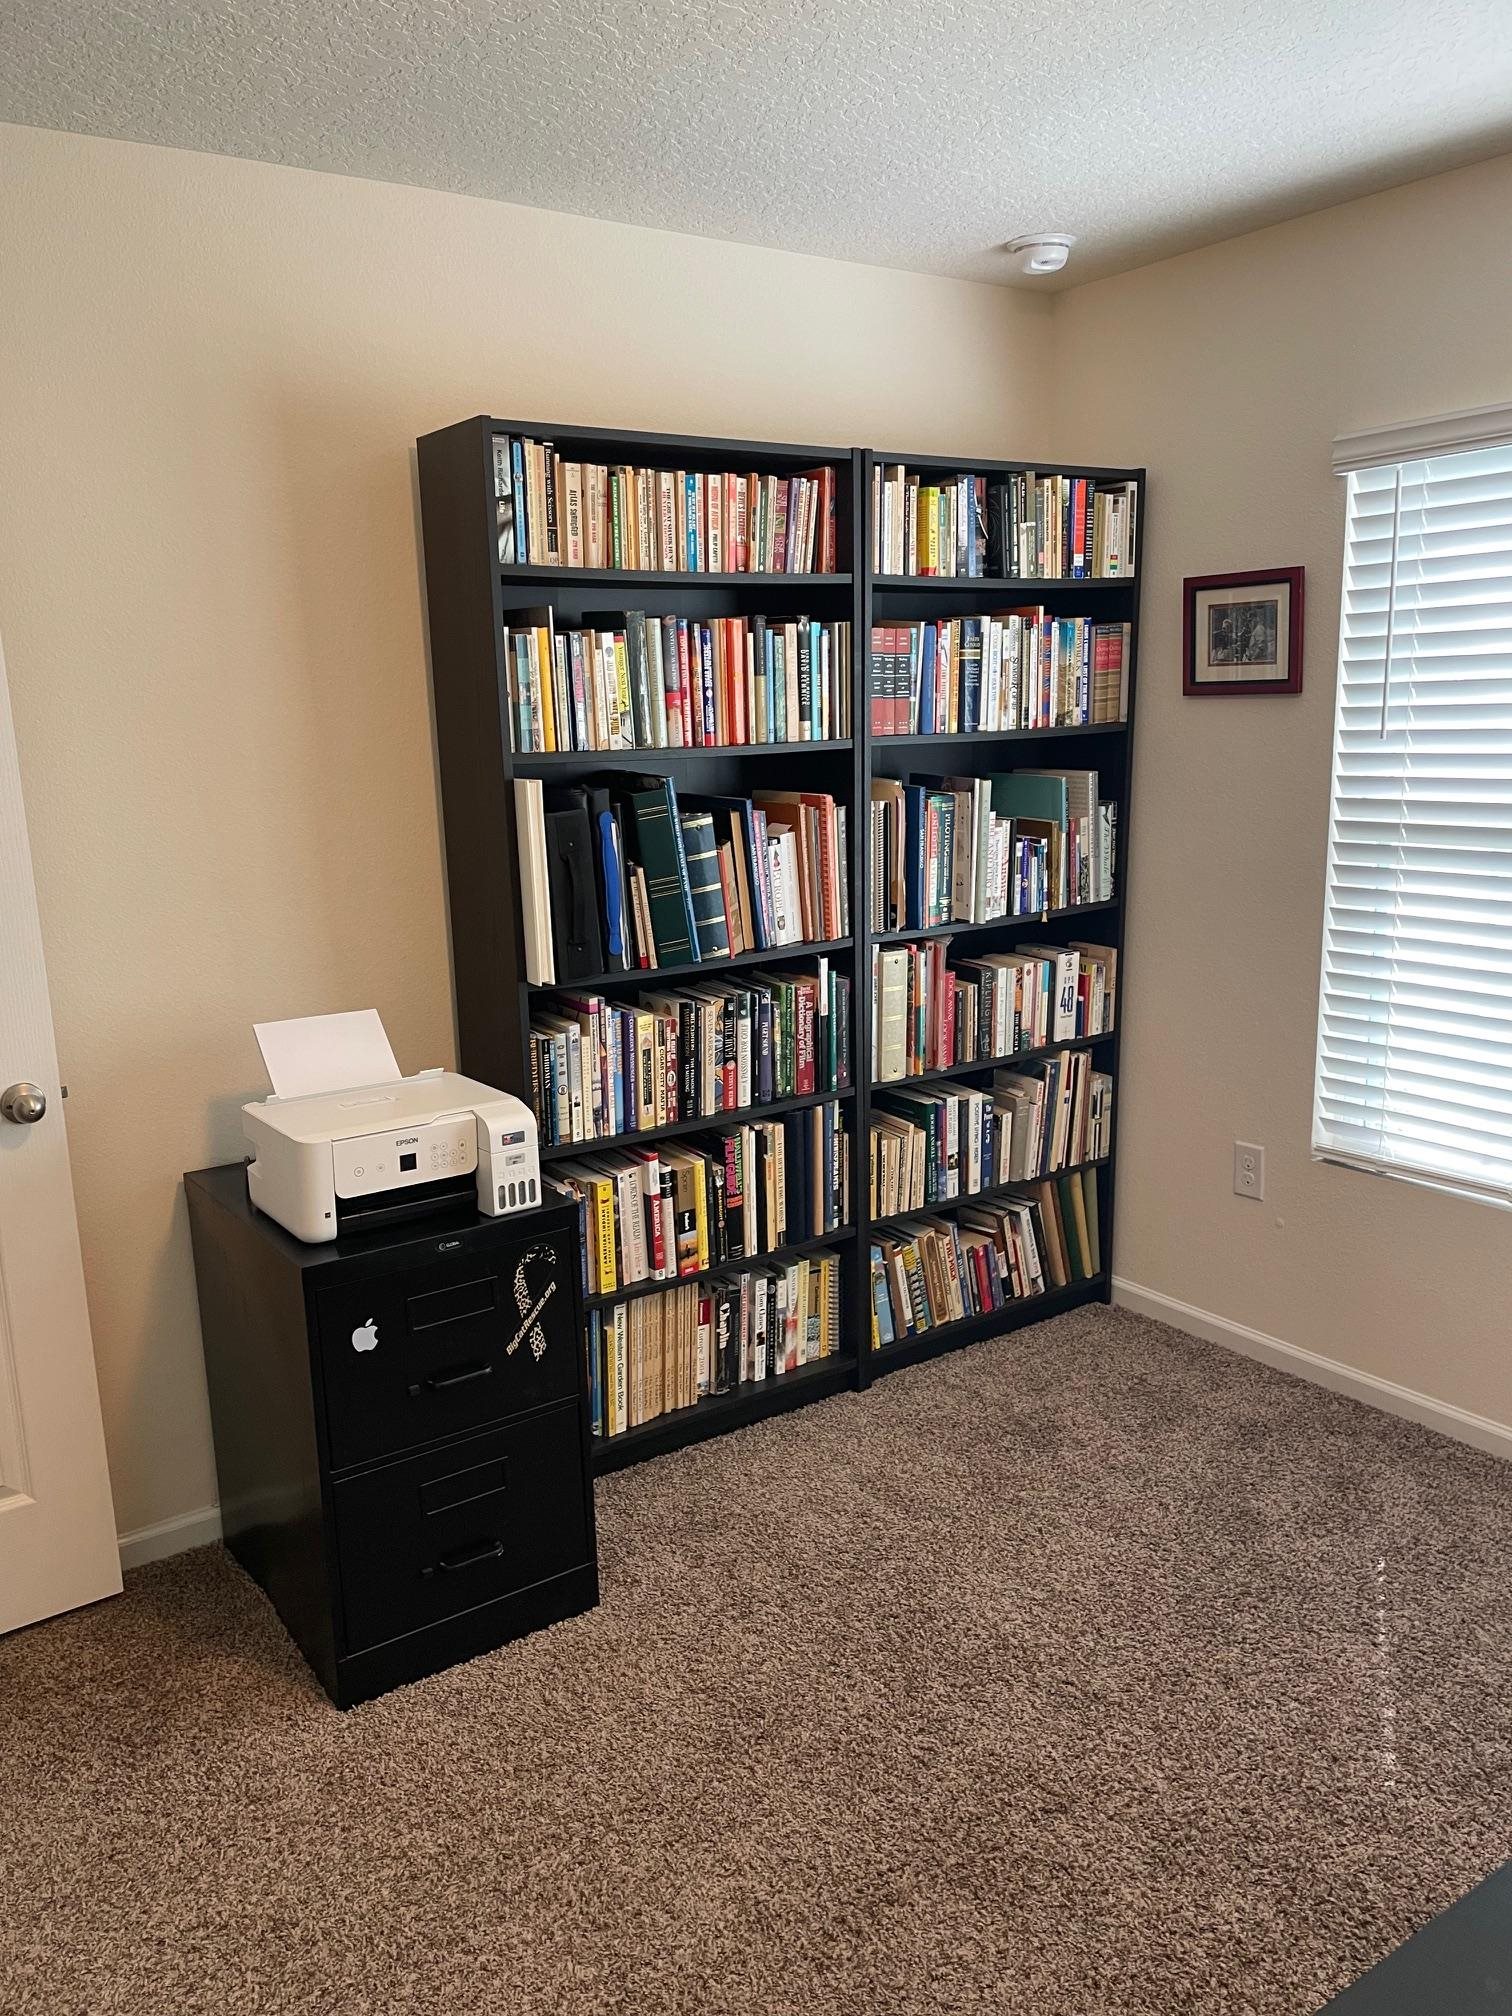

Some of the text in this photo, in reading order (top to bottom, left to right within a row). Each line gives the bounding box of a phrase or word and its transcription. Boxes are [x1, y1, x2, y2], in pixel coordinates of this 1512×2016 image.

[498, 500, 506, 513] Life
[569, 489, 577, 507] ATLAS
[738, 491, 746, 510] DEVIL'S
[614, 516, 618, 524] IN
[617, 646, 625, 672] Younger
[943, 813, 951, 856] PILOTING
[752, 858, 760, 886] FRANCISCO
[773, 868, 784, 913] EUROPE
[984, 971, 992, 1017] KIPLING
[1059, 985, 1075, 1014] 48
[740, 1023, 749, 1040] GOLF
[797, 996, 806, 1040] Dictionary
[803, 1001, 813, 1062] A Biographical
[707, 1036, 715, 1066] ARROWS
[724, 1017, 734, 1058] GAME TIME
[740, 1041, 749, 1053] FOR
[798, 1040, 806, 1049] of
[740, 1054, 749, 1079] PASSION
[395, 1137, 419, 1147] EPSON
[680, 1171, 691, 1193] Spain
[725, 1139, 736, 1196] FILM GUIDE
[628, 1179, 641, 1241] LORDS OF THE REALM
[653, 1199, 661, 1237] AMERICA
[945, 1241, 957, 1282] THE MICK
[506, 1281, 557, 1356] BigCatRescue.org
[715, 1302, 731, 1350] Chaplin
[697, 1327, 706, 1356] Europe
[617, 1362, 625, 1390] Garden
[617, 1391, 625, 1412] Book
